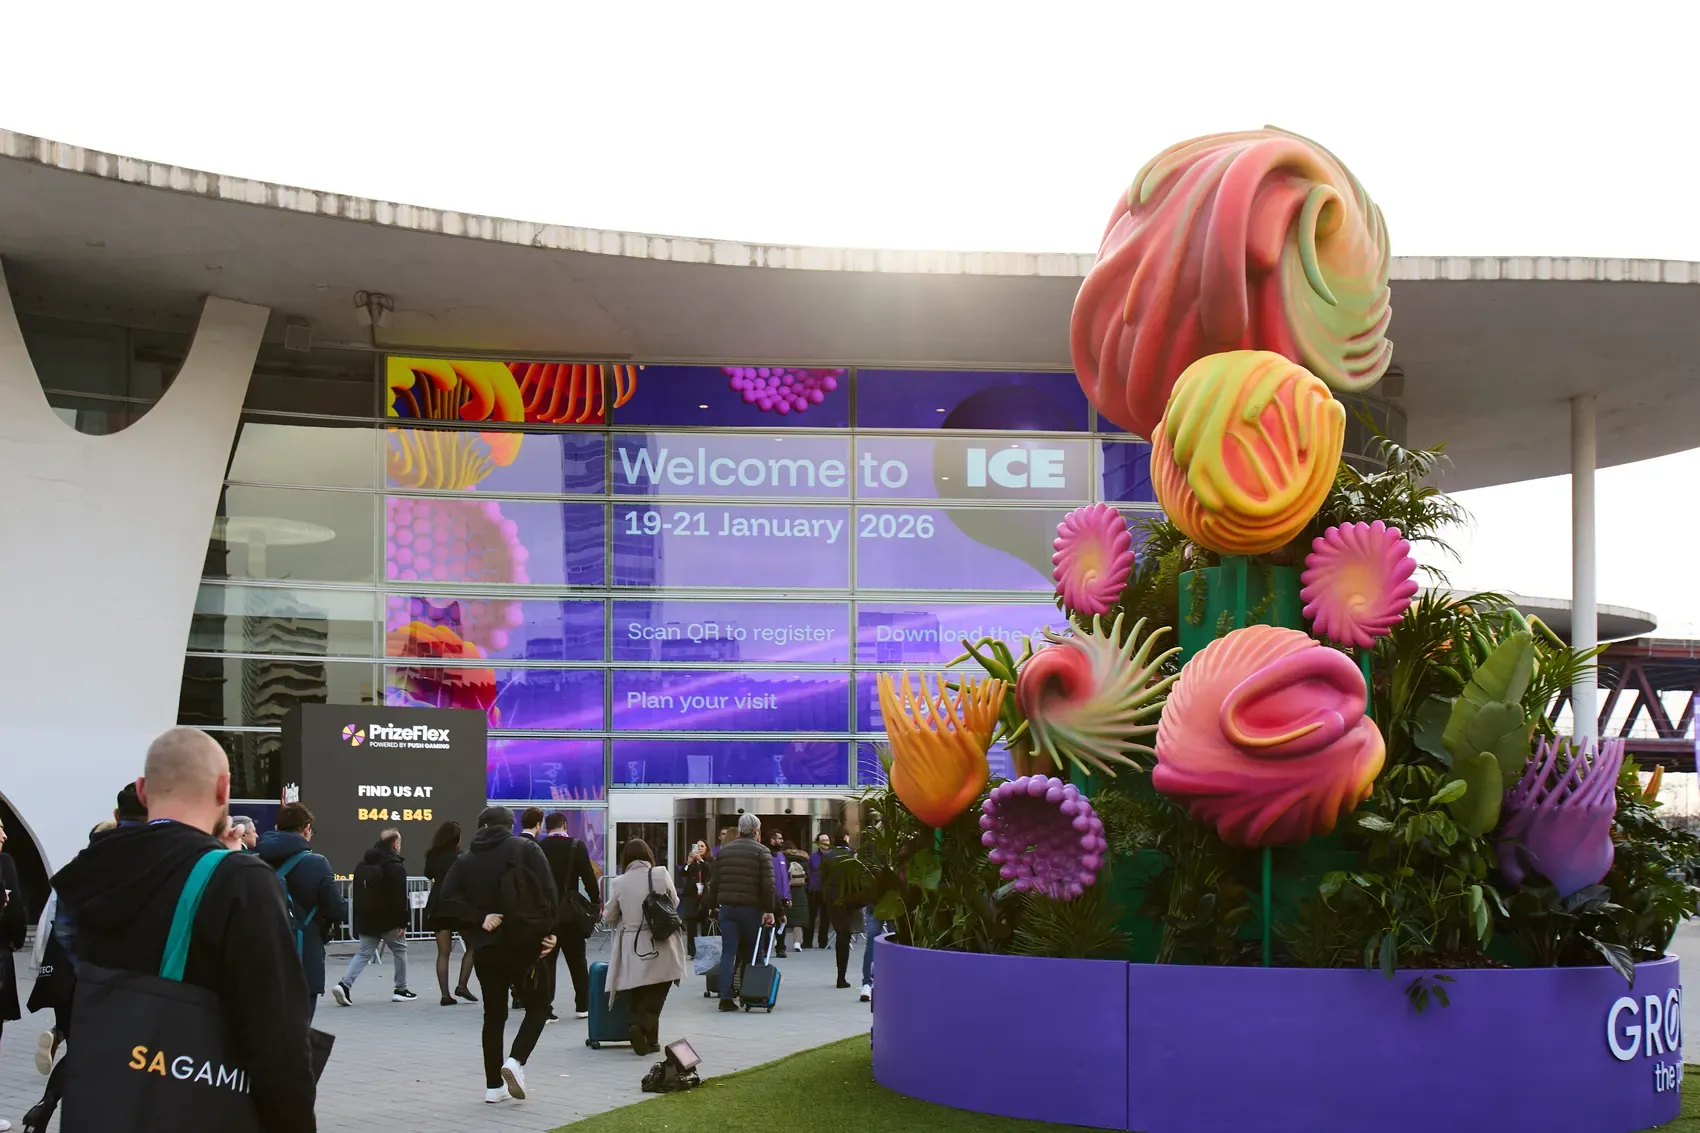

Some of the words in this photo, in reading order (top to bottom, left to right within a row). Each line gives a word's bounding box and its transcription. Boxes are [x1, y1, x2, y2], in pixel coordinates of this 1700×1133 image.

[618, 447, 846, 488] Welcome
[859, 452, 908, 488] to
[966, 447, 1066, 488] ICE
[624, 510, 710, 536] 19-21
[718, 511, 844, 544] January
[859, 513, 935, 538] 2026
[627, 622, 681, 641] Scan
[687, 623, 719, 644] QR
[725, 624, 747, 641] to
[753, 624, 835, 646] register
[876, 624, 983, 643] Download
[989, 625, 1024, 643] the
[626, 691, 674, 709] Plan
[680, 694, 729, 713] your
[734, 692, 778, 710] visit
[369, 722, 450, 742] PrizeFlex
[424, 742, 451, 750] GAMING
[358, 785, 392, 797] FIND
[393, 785, 412, 798] US
[413, 786, 433, 798] AT
[358, 808, 389, 821] B44
[390, 811, 401, 821] &
[403, 808, 433, 821] B45
[1607, 987, 1683, 1061] GRO
[1655, 1060, 1676, 1092] the
